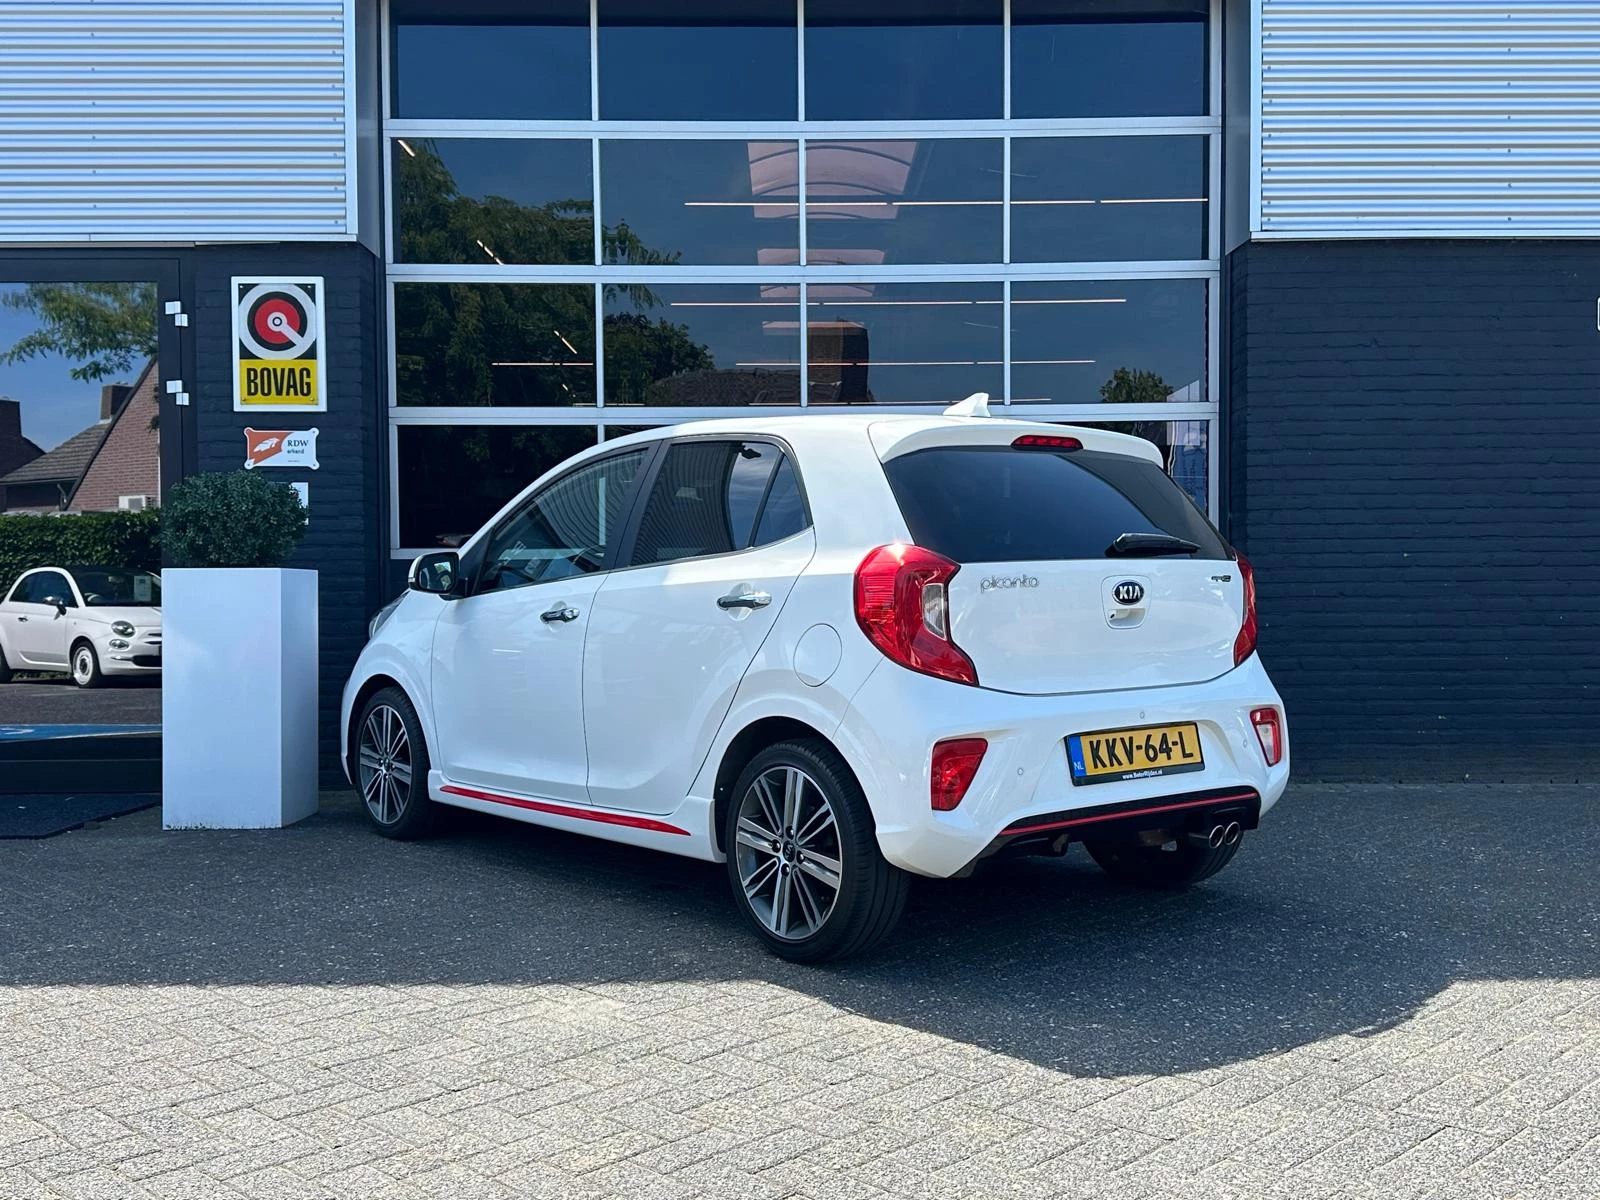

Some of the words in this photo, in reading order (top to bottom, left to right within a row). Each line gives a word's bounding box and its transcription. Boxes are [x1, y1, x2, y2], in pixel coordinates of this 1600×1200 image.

[246, 367, 312, 397] BOVAG
[287, 439, 309, 447] RDW
[980, 574, 1039, 594] picanto
[1119, 585, 1141, 600] KIA
[1089, 731, 1194, 769] KKV-64-L
[1073, 761, 1084, 770] NL
